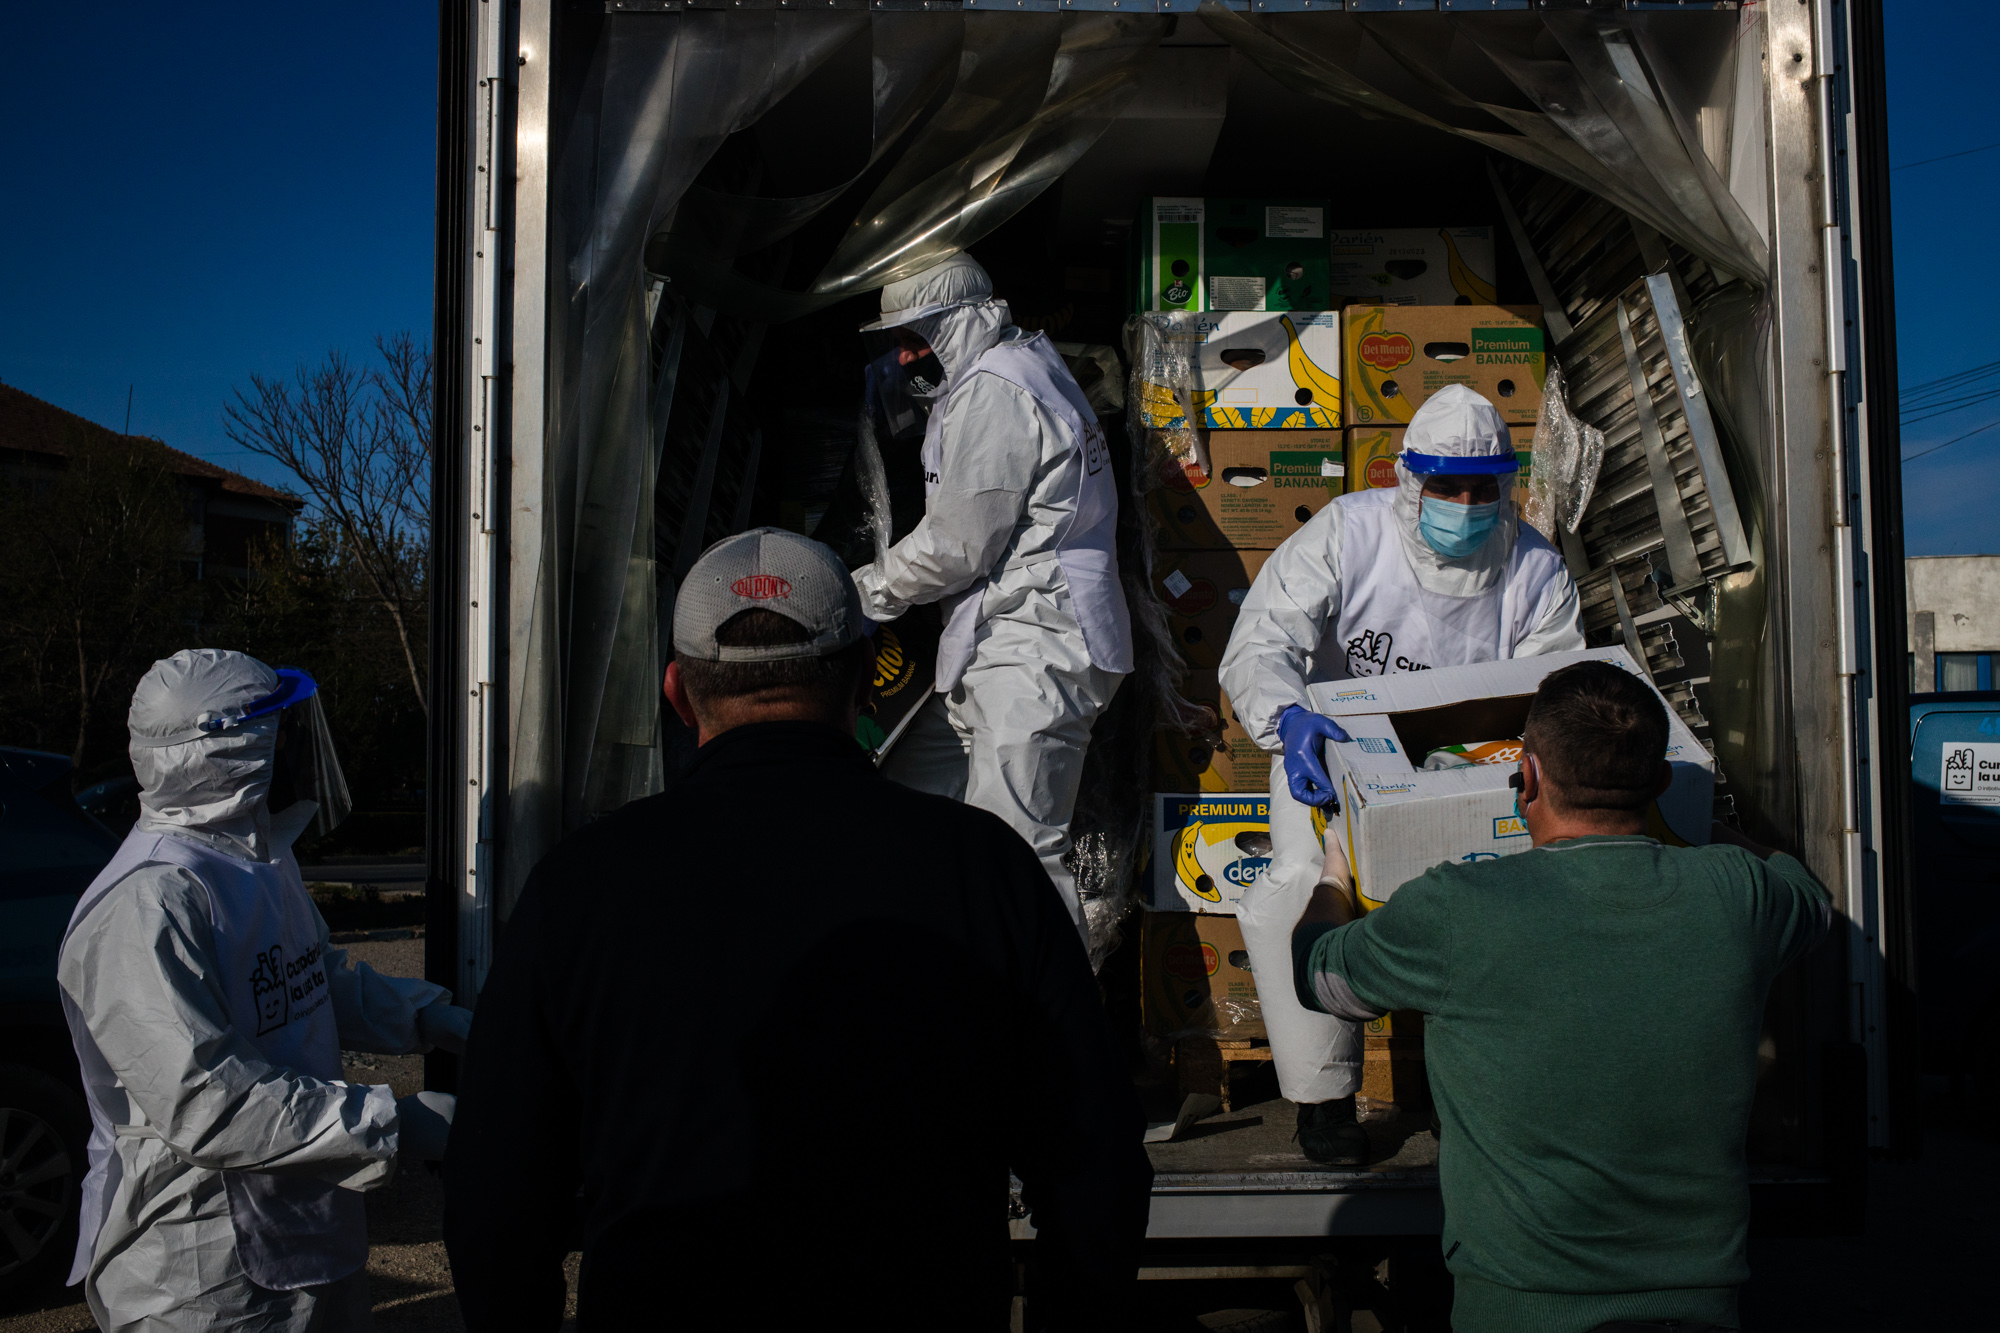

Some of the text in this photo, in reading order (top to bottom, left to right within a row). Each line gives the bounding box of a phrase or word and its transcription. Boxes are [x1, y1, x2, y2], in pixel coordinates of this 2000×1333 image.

[1168, 287, 1188, 302] Bio
[1363, 344, 1410, 355] Del Monte
[1475, 340, 1530, 351] Premium
[1476, 354, 1540, 365] BANANAS
[1370, 469, 1385, 479] Del
[1274, 478, 1338, 489] BANANAS
[880, 660, 916, 699] PREMIUM BANANAS
[1979, 772, 1990, 781] la
[1178, 803, 1253, 816] PREMIUM
[290, 986, 304, 1003] la
[312, 971, 325, 987] ta
